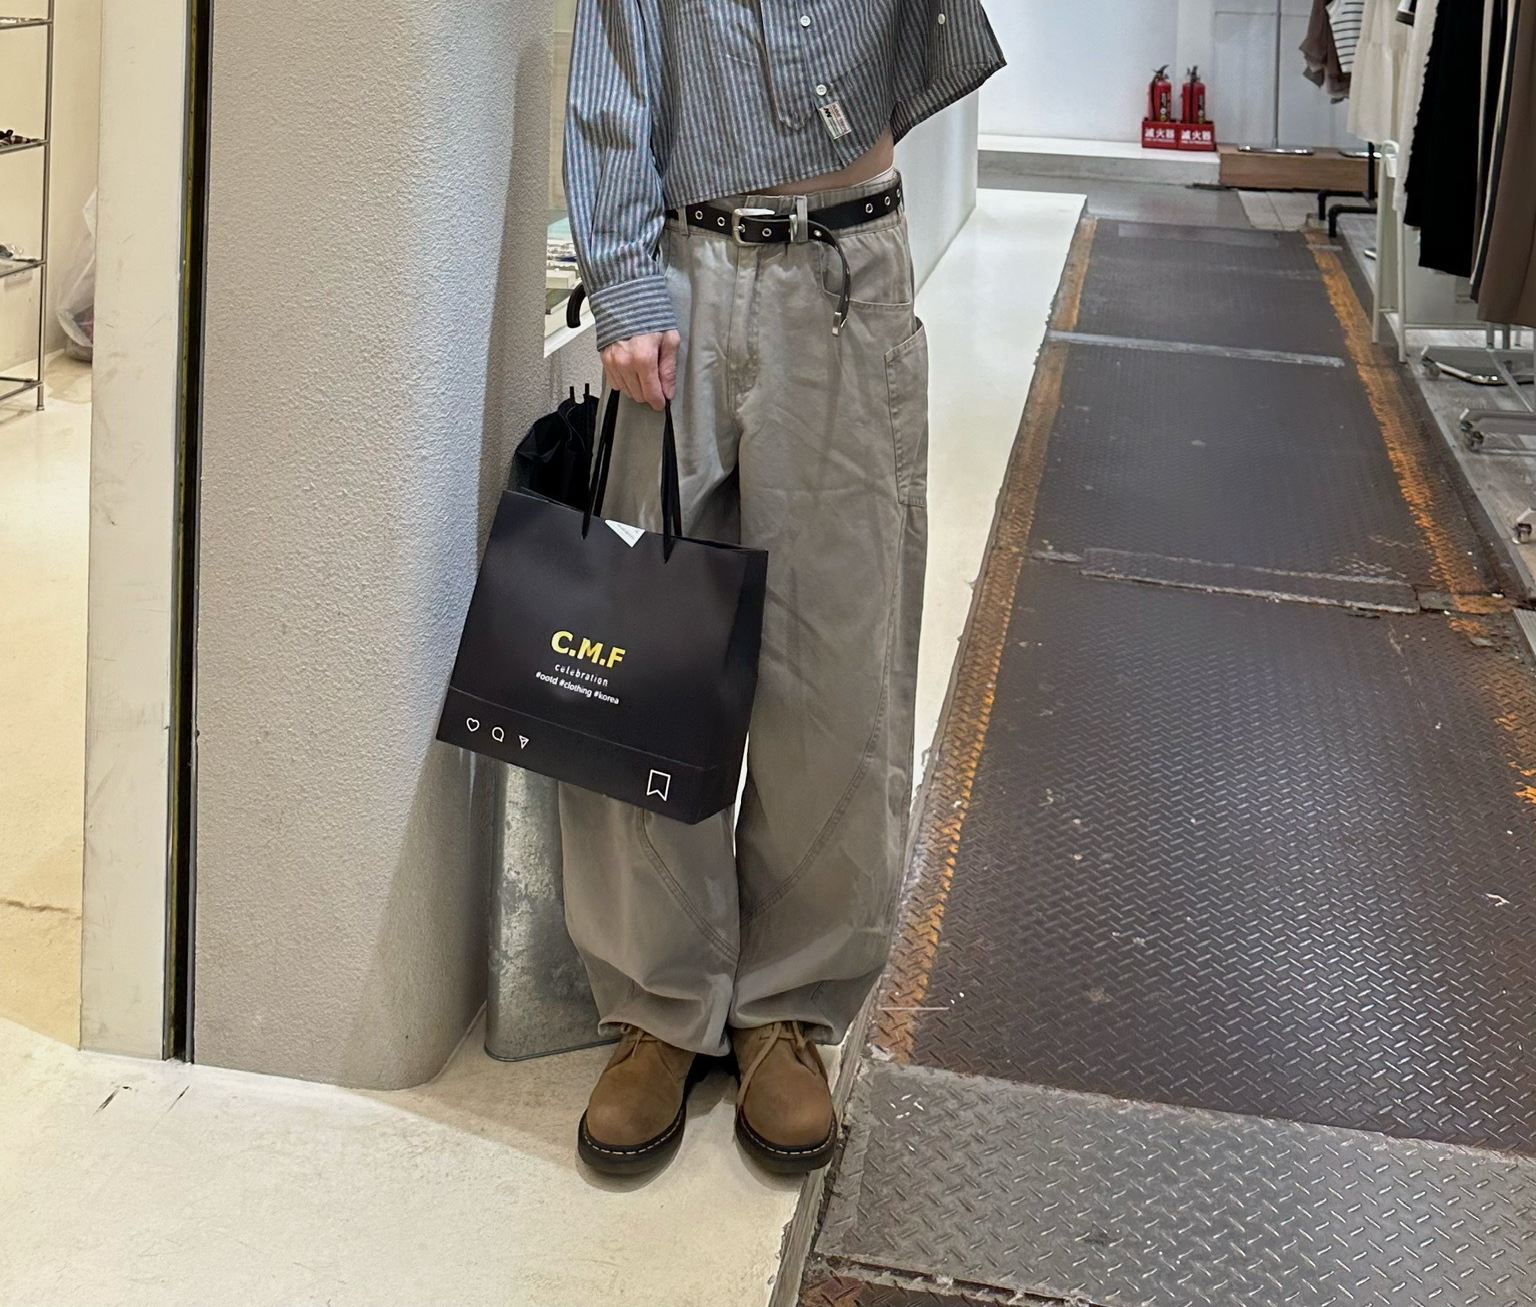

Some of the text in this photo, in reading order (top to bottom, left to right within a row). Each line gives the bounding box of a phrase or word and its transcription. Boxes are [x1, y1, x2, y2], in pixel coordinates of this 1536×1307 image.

[551, 630, 626, 668] C.M.F
[535, 671, 620, 705] #ootd #clothing #korea
